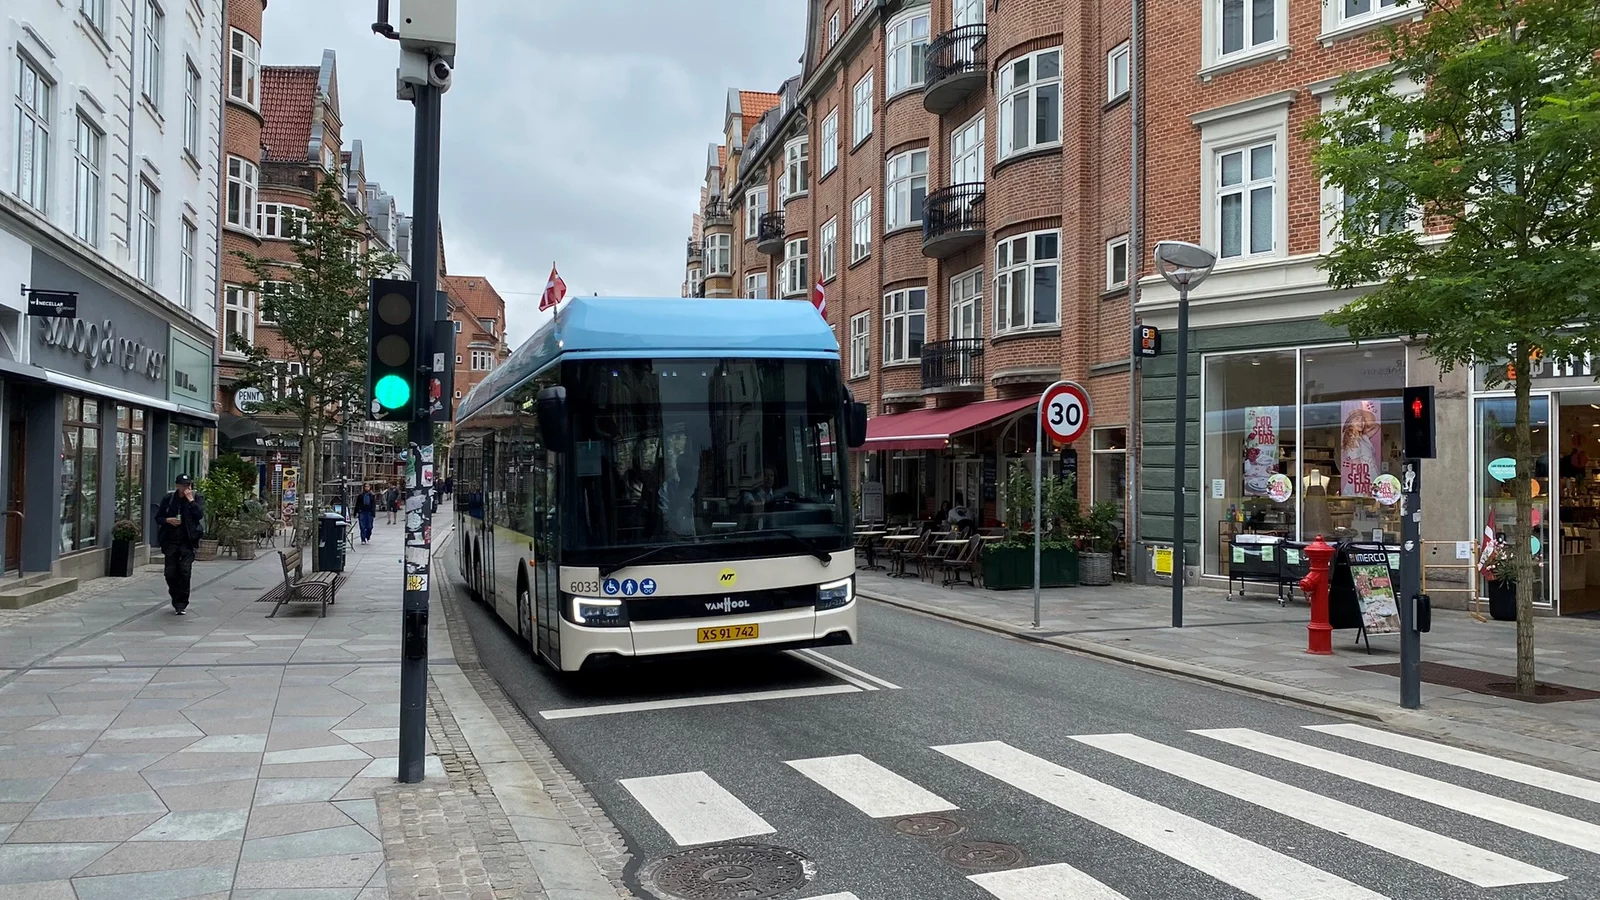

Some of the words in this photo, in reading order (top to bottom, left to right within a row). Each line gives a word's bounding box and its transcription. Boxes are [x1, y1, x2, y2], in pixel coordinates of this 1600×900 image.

[1050, 402, 1081, 426] 30
[1256, 416, 1272, 427] FØD
[1252, 426, 1273, 436] SELS
[1258, 434, 1276, 445] DAG
[1351, 463, 1370, 474] FØD
[1348, 473, 1371, 485] SELS
[720, 573, 735, 581] NT
[570, 581, 599, 593] 6033
[703, 629, 717, 640] XS
[719, 628, 731, 639] 91
[735, 626, 754, 637] 742
